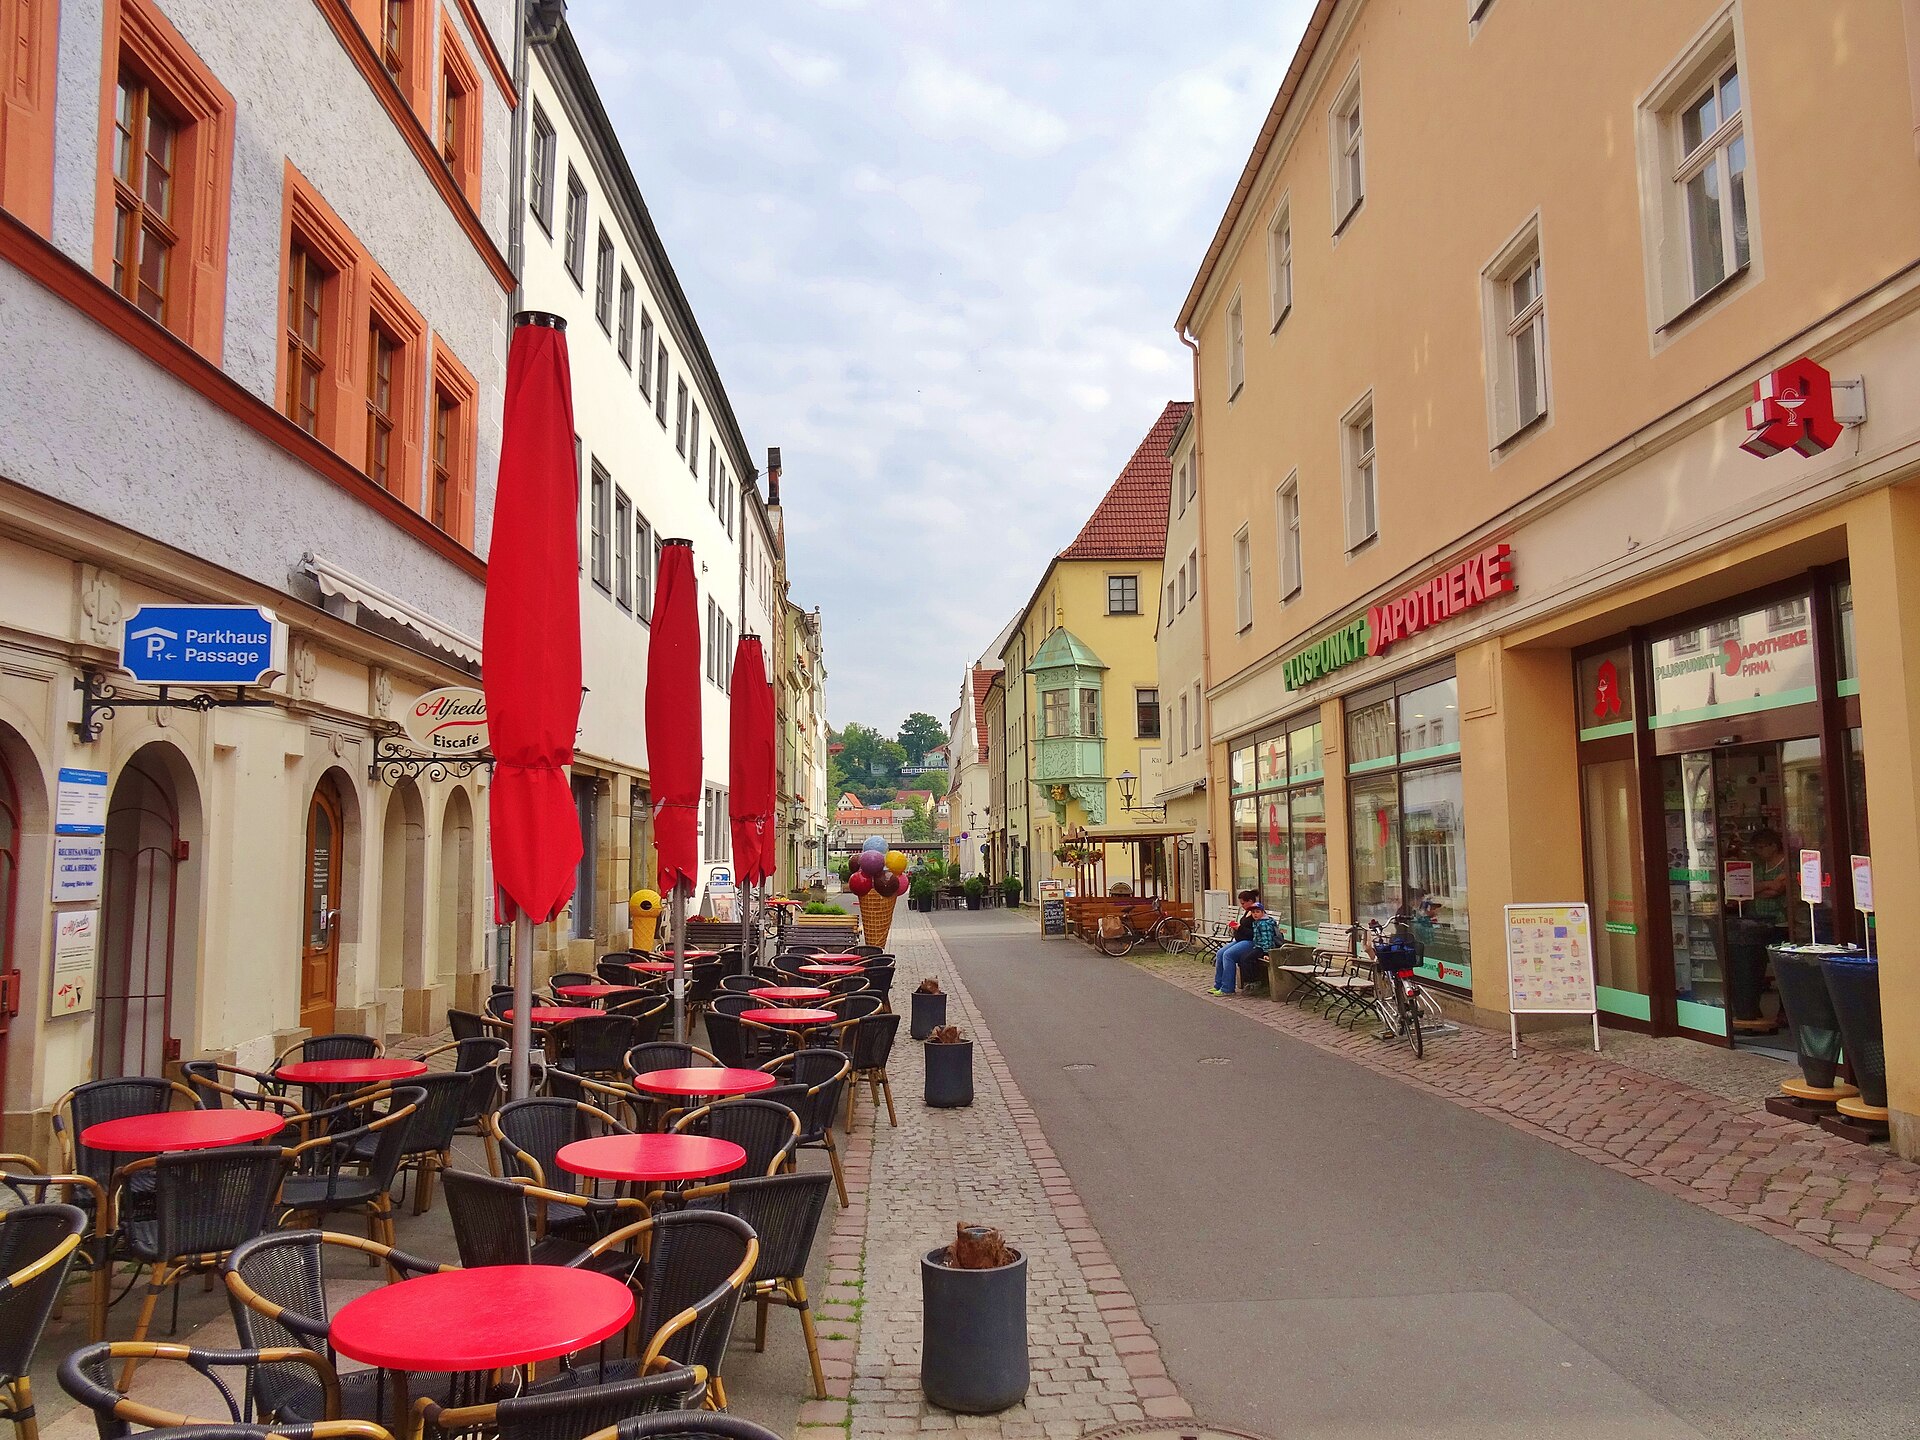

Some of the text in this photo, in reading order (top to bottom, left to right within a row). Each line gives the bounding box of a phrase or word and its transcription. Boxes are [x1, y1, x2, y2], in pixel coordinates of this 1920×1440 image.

[1283, 544, 1513, 692] PLUSPUNKT APOTHEKE
[186, 629, 268, 644] Parkhaus
[185, 648, 259, 666] Passage
[1655, 629, 1808, 680] PLUSPUNKT APOTHEKE
[1742, 660, 1772, 678] PIRNA
[416, 696, 487, 720] Alfredo
[433, 733, 479, 748] Eiscafé
[1510, 916, 1555, 925] Guten Tag
